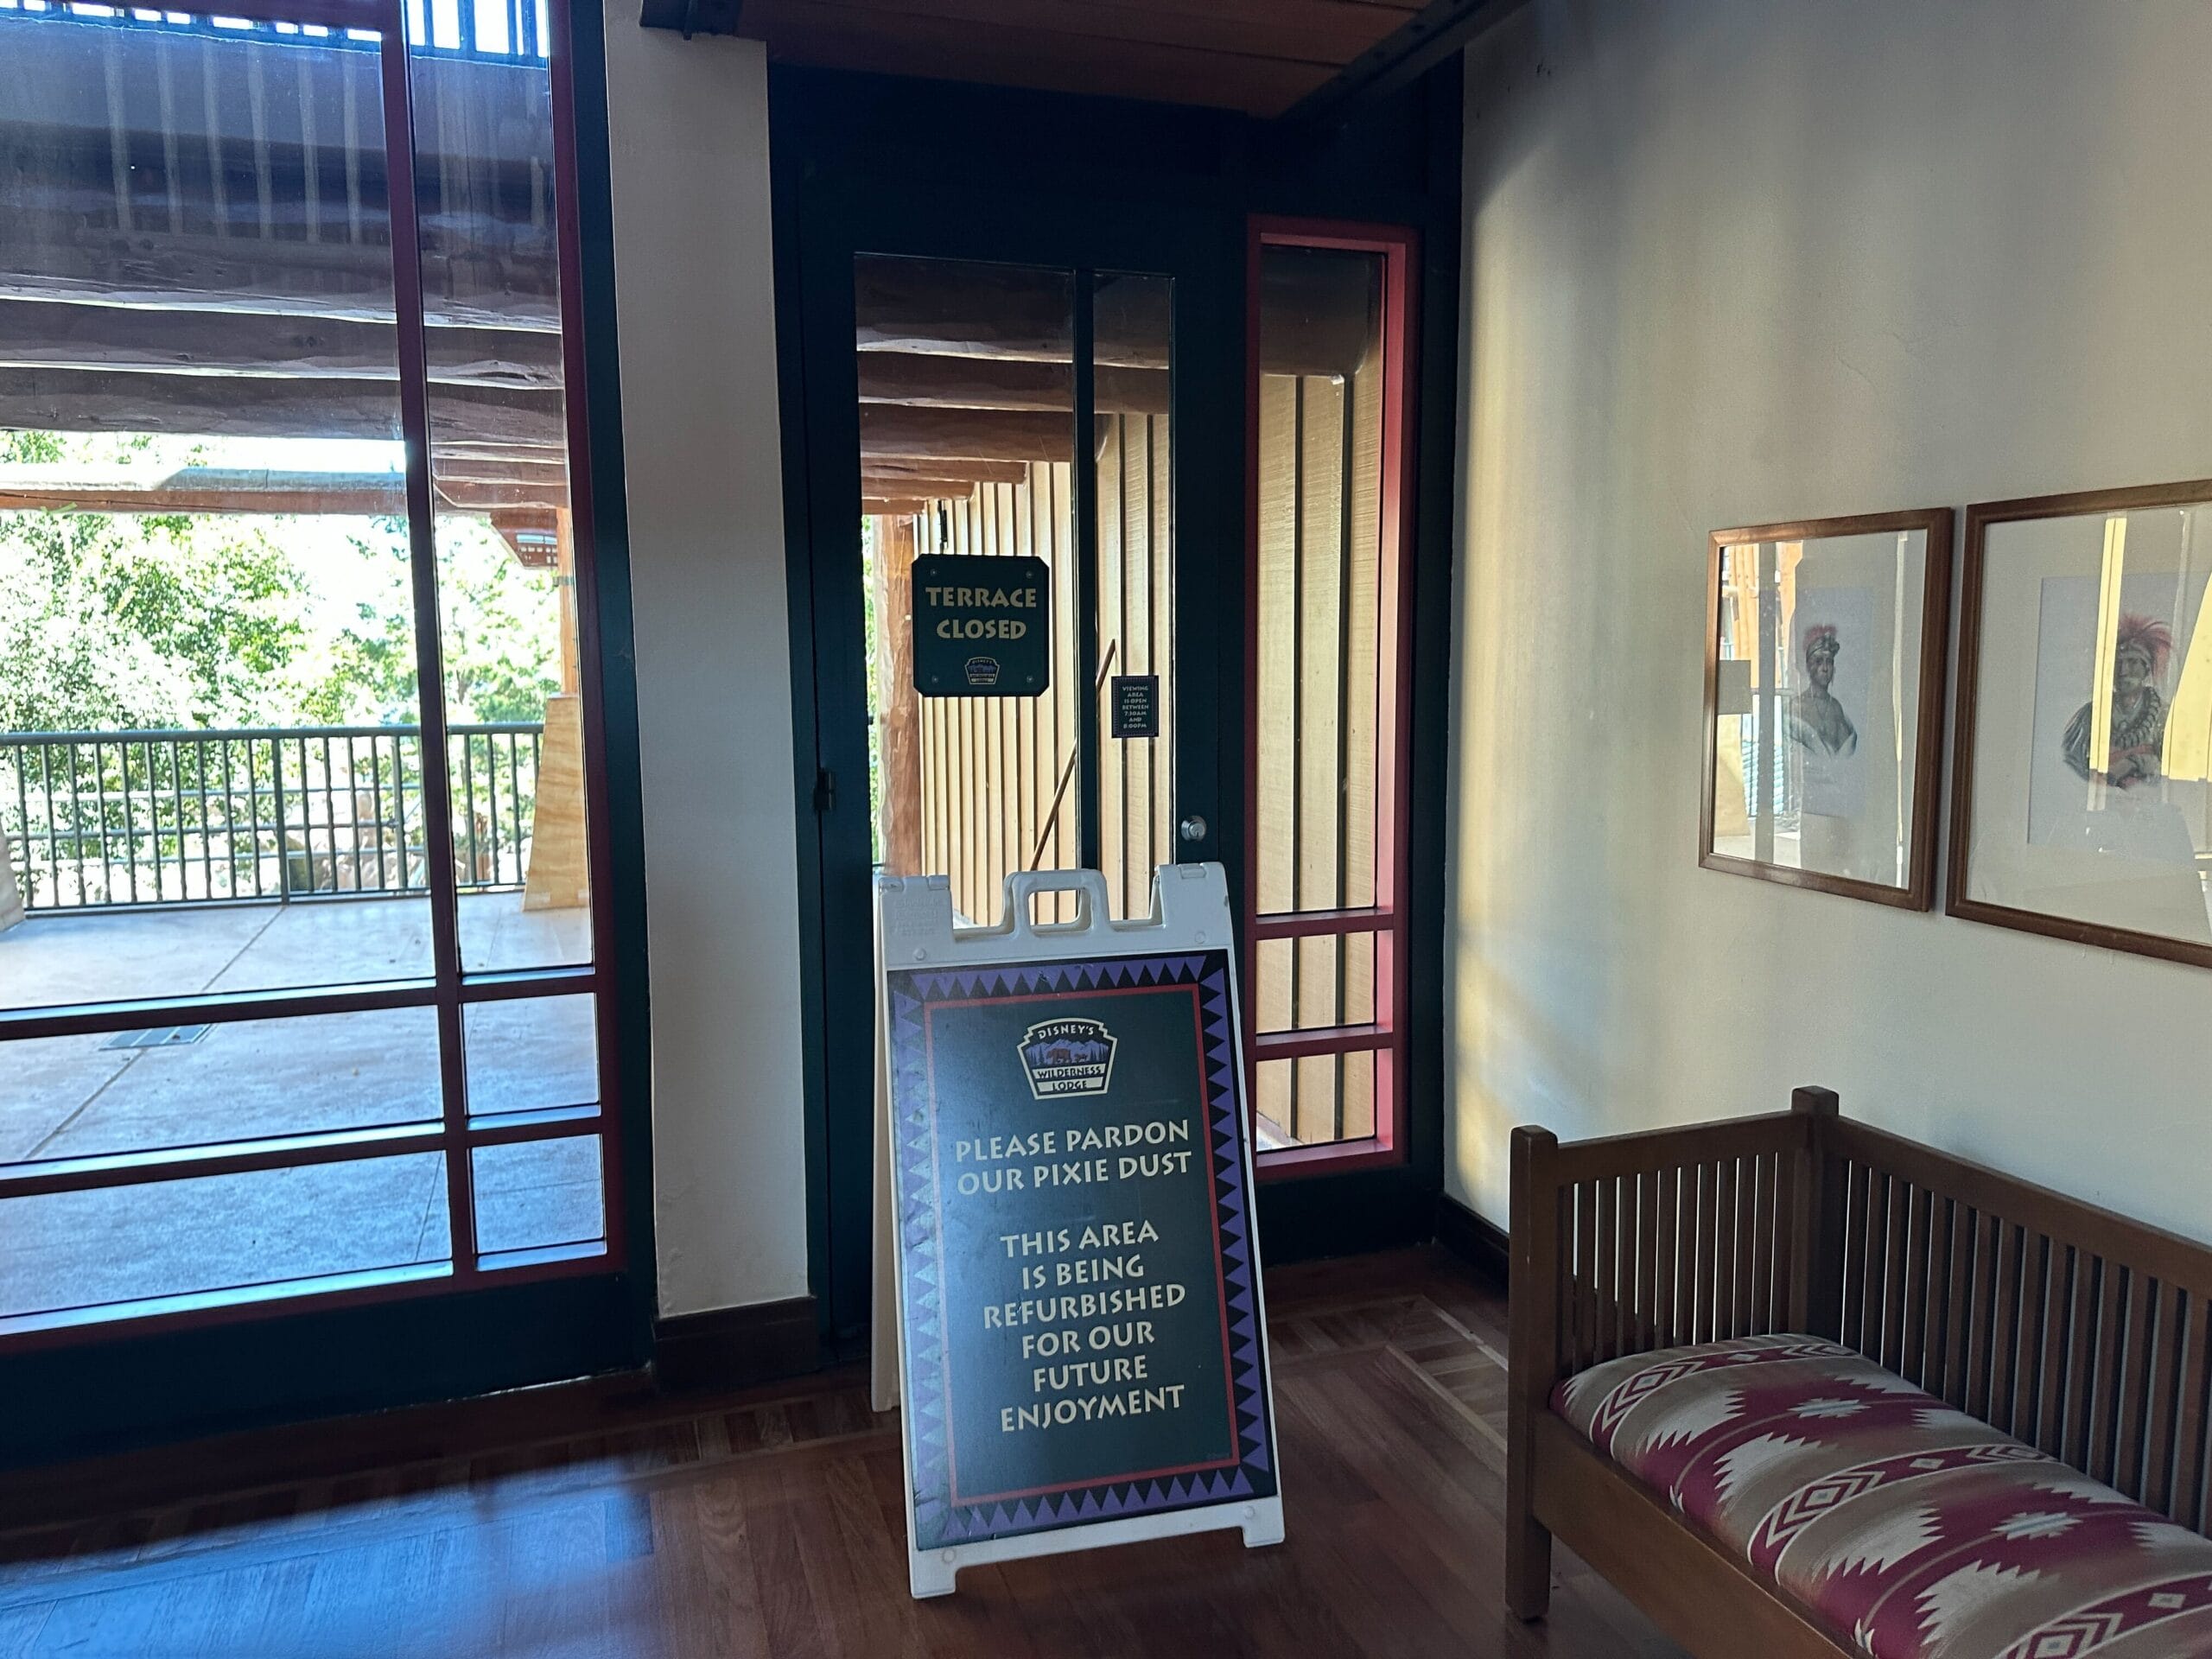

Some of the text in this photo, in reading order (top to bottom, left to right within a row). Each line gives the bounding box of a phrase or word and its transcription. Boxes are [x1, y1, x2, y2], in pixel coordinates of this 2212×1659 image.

[925, 587, 1037, 608] TERRACE
[936, 619, 1027, 639] CLOSED
[1038, 1024, 1095, 1039] DISNEY'S
[1037, 1065, 1102, 1079] WILDERNESS
[1052, 1079, 1087, 1091] LODGE
[955, 1118, 1189, 1162] PLEASE PARDON
[957, 1150, 1192, 1196] OUR PIXIE DUST
[1000, 1218, 1160, 1258] THIS AREA
[1022, 1253, 1145, 1290] IS BEING
[983, 1283, 1186, 1329] REFURBISHED
[1022, 1320, 1155, 1359] FOR OUR
[1033, 1354, 1148, 1393] FUTURE
[1001, 1383, 1185, 1433] ENJOYMENT
